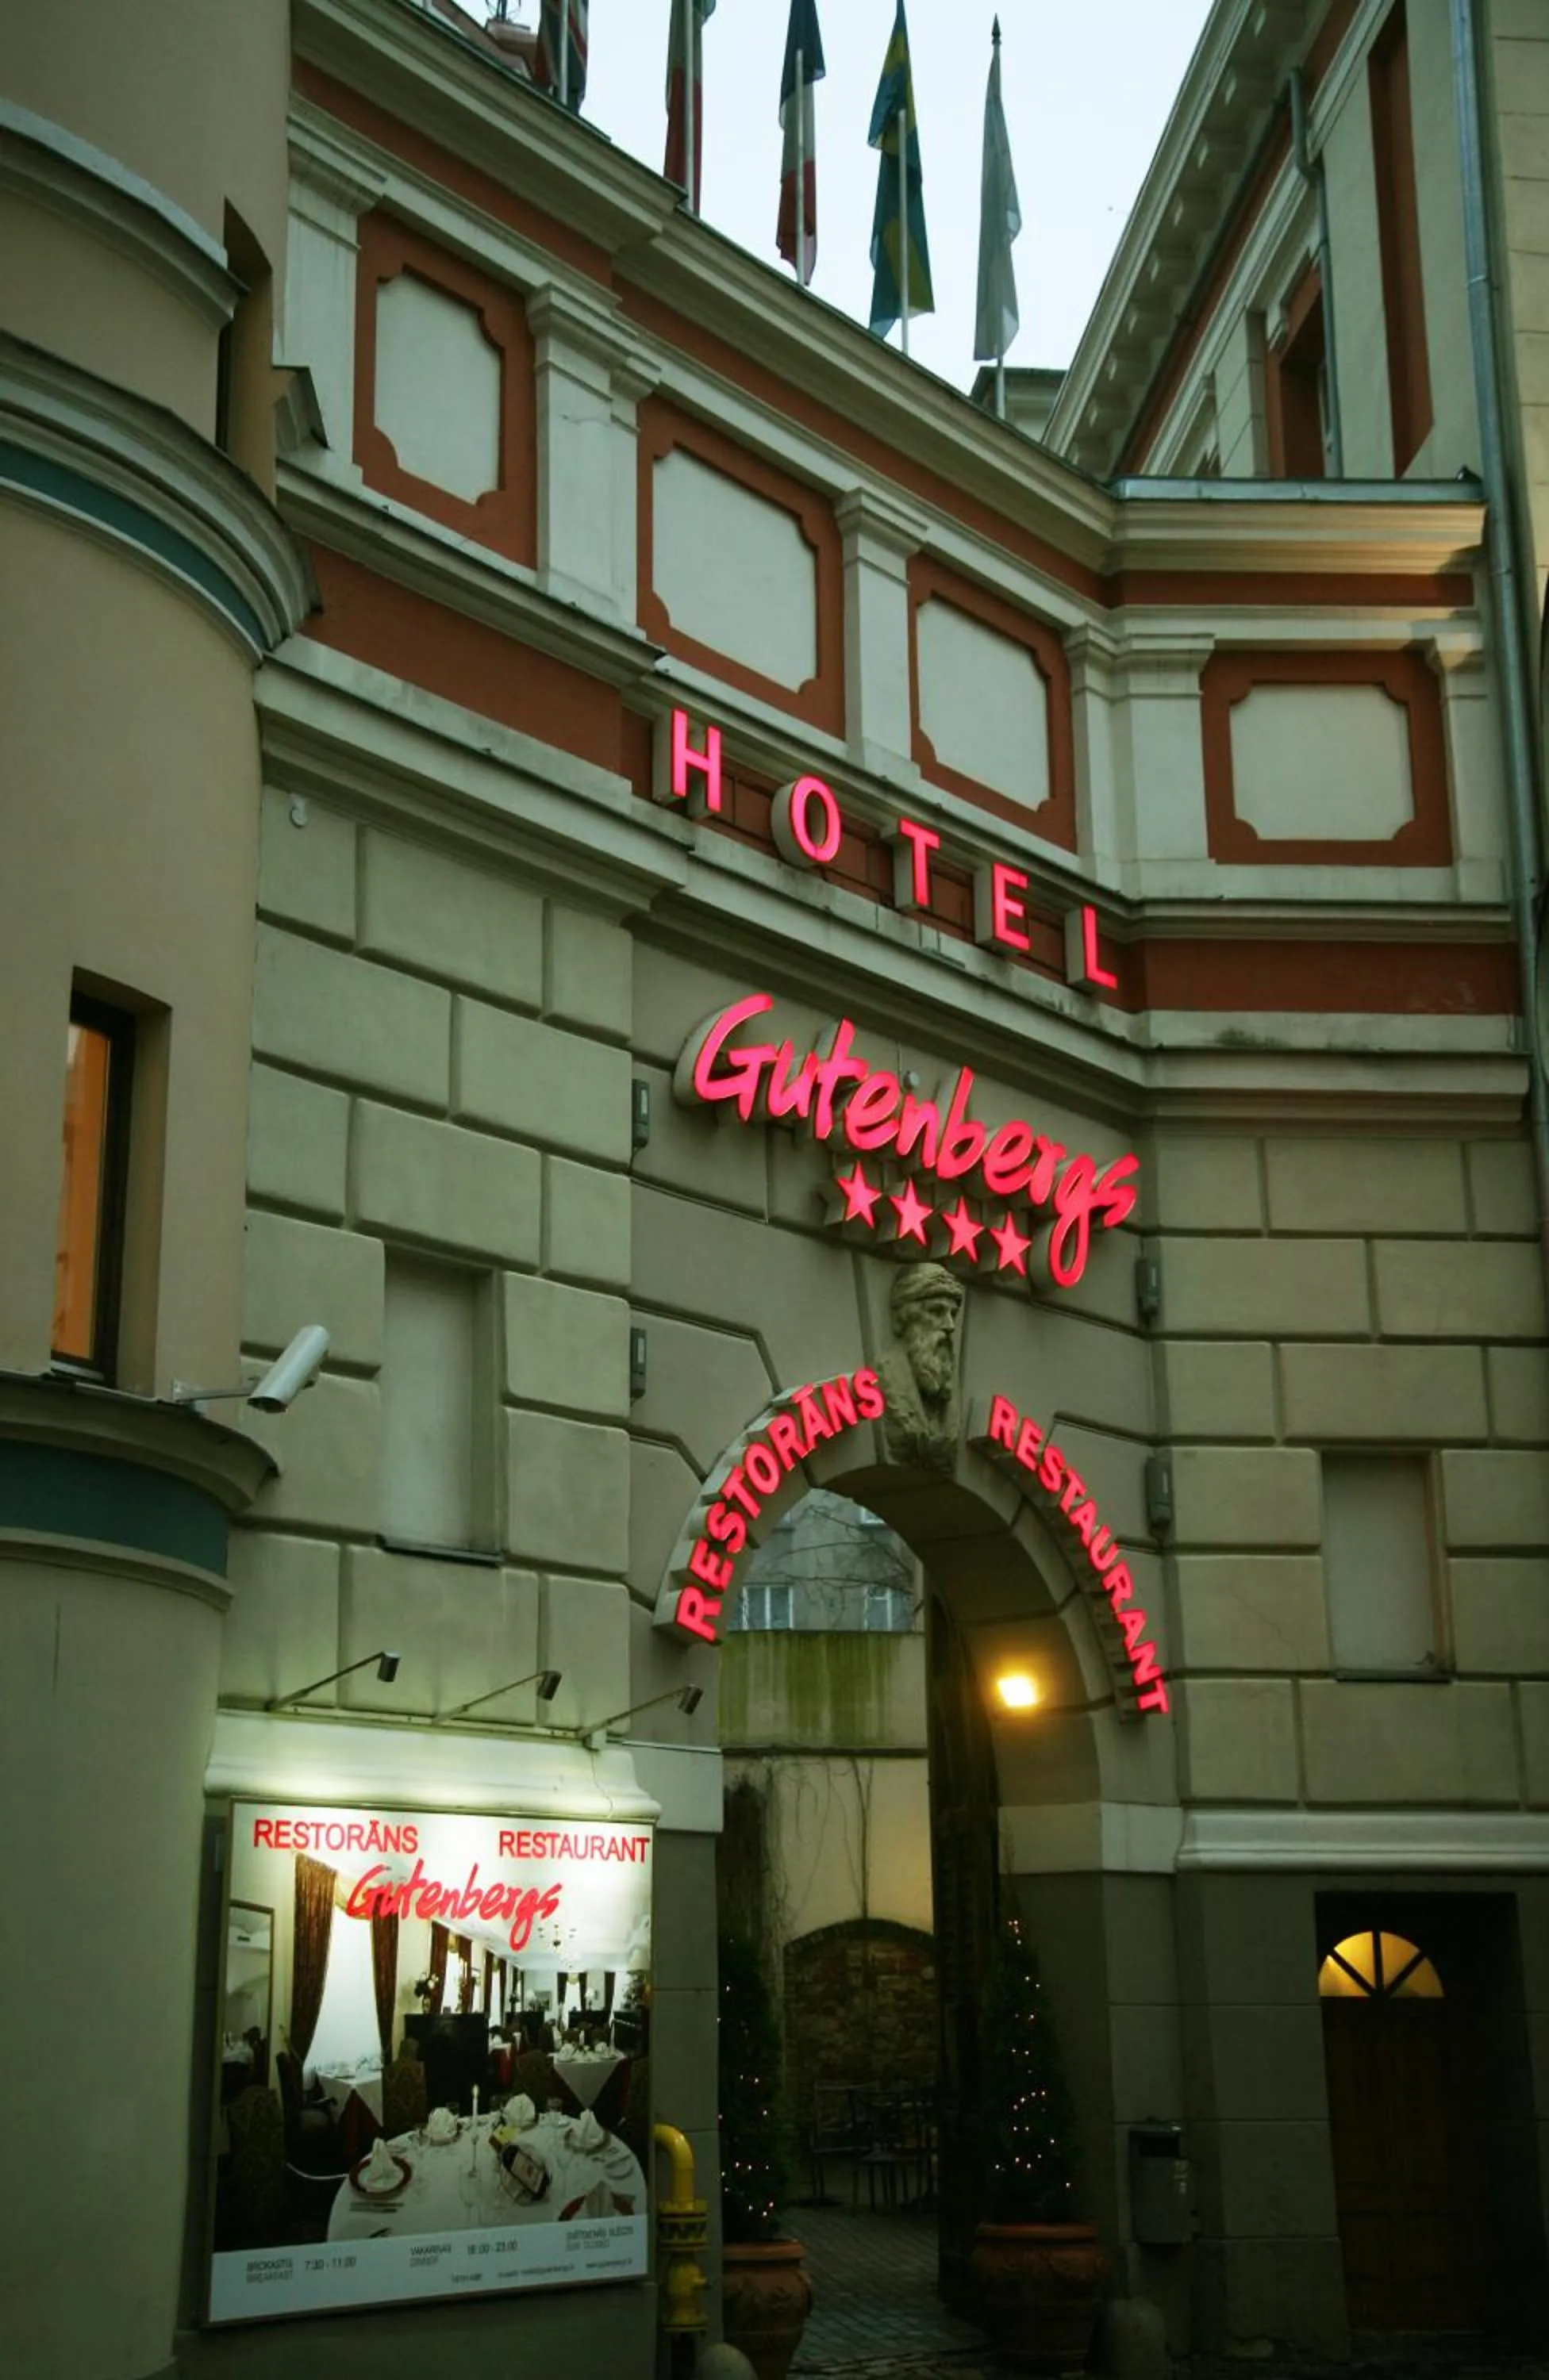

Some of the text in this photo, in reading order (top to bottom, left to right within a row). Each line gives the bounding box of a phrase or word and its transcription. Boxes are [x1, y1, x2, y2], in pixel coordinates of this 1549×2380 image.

[672, 709, 1117, 989] HOTEL
[694, 992, 1140, 1288] Gutenbergs
[677, 1366, 885, 1641] RESTORĀNS
[989, 1394, 1169, 1714] RESTAURANT
[253, 1819, 419, 1854] RESTORĀNS
[345, 1858, 563, 1952] Gutenbergs
[498, 1829, 651, 1863] RESTAURANT
[305, 2259, 325, 2271] 7:30
